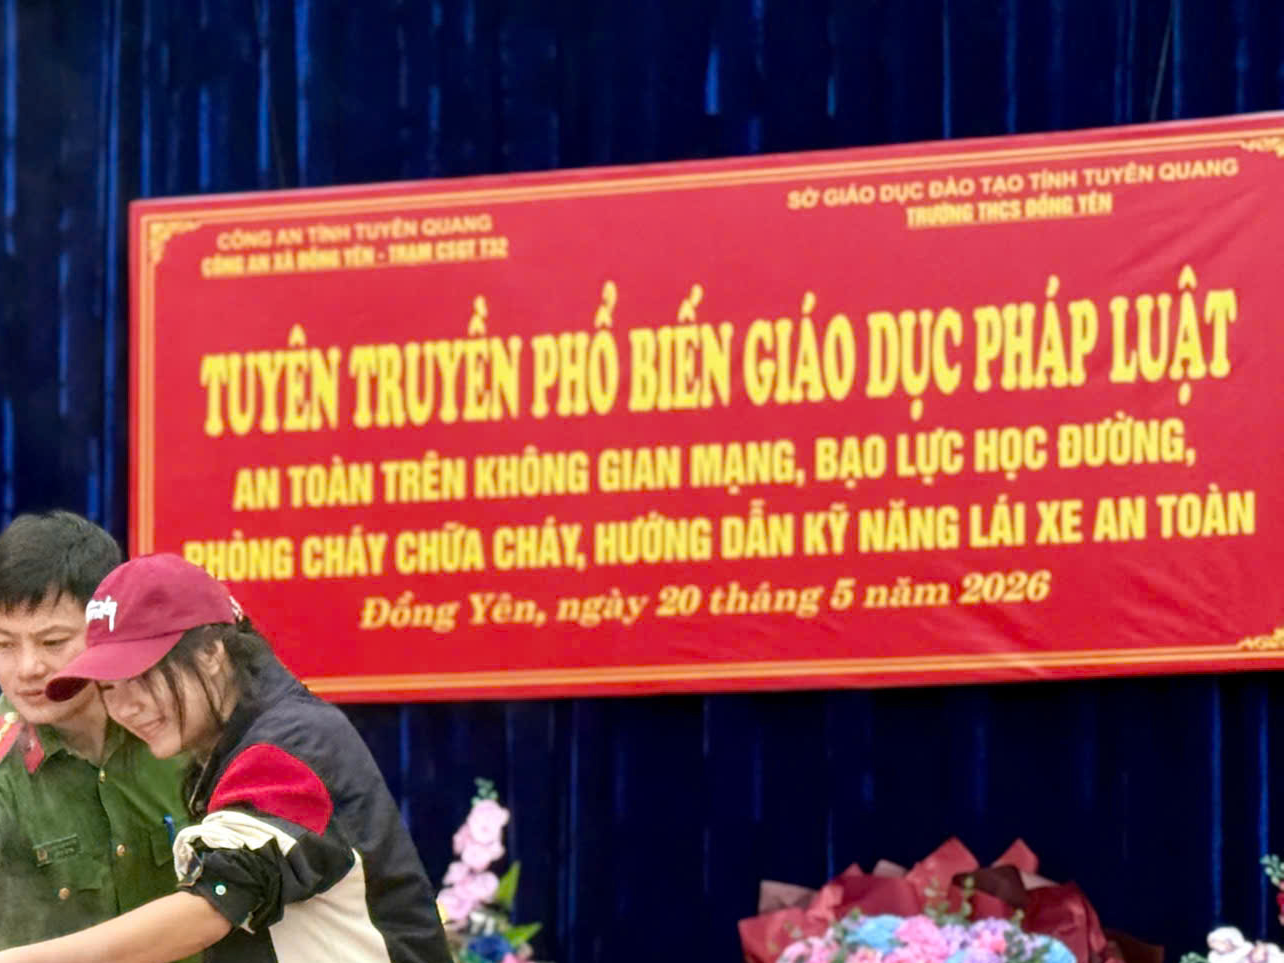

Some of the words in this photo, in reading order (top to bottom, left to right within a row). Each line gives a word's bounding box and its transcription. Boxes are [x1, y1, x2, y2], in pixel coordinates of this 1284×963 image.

[787, 185, 820, 210] SỞ
[823, 182, 876, 207] GIÁO
[879, 180, 924, 205] DỤC
[928, 174, 975, 199] ĐÀO
[980, 174, 1024, 198] TẠO
[1083, 161, 1154, 187] TUYÊN
[1159, 157, 1239, 181] QUANG
[217, 227, 273, 251] CÔNG
[277, 227, 303, 246] AN
[355, 216, 418, 241] TUYÊN
[421, 213, 493, 236] QUANG
[247, 253, 270, 275] AN
[200, 324, 341, 437] TUYÊN
[349, 295, 522, 428] TRUYỀN
[531, 280, 619, 419] PHỔ
[629, 284, 733, 412] BIẾN
[743, 291, 856, 406] GIÁO
[866, 308, 963, 421] DỤC
[973, 275, 1099, 392] PHÁP
[1110, 264, 1237, 406] LUẬT
[232, 468, 279, 511] AN
[288, 455, 374, 508] TOÀN
[381, 451, 467, 503] TRÊN
[475, 445, 589, 498] KHÔNG
[598, 446, 680, 491] GIAN
[690, 440, 806, 495] MẠNG,
[815, 434, 887, 489] BẠO
[897, 427, 964, 486] LỰC
[975, 426, 1048, 481] HỌC
[1058, 411, 1196, 468] ĐƯỜNG,
[183, 528, 294, 582] PHÒNG
[301, 524, 388, 578] CHÁY
[396, 521, 484, 575] CHỮA
[492, 515, 586, 571] CHÁY,
[595, 511, 712, 565] HƯỚNG
[721, 498, 794, 560] DẪN
[802, 502, 849, 556] KỸ
[858, 499, 960, 553] NĂNG
[969, 493, 1026, 548] LÁI
[1036, 499, 1084, 545] XE
[1093, 496, 1146, 542] AN
[1156, 483, 1256, 539] TOÀN
[359, 589, 460, 633] Đồng
[468, 592, 547, 628] Yên,
[556, 588, 648, 630] ngày
[656, 585, 703, 617] 20
[708, 580, 824, 619] tháng
[830, 578, 856, 610] 5
[864, 576, 950, 610] năm
[958, 570, 1052, 605] 2026
